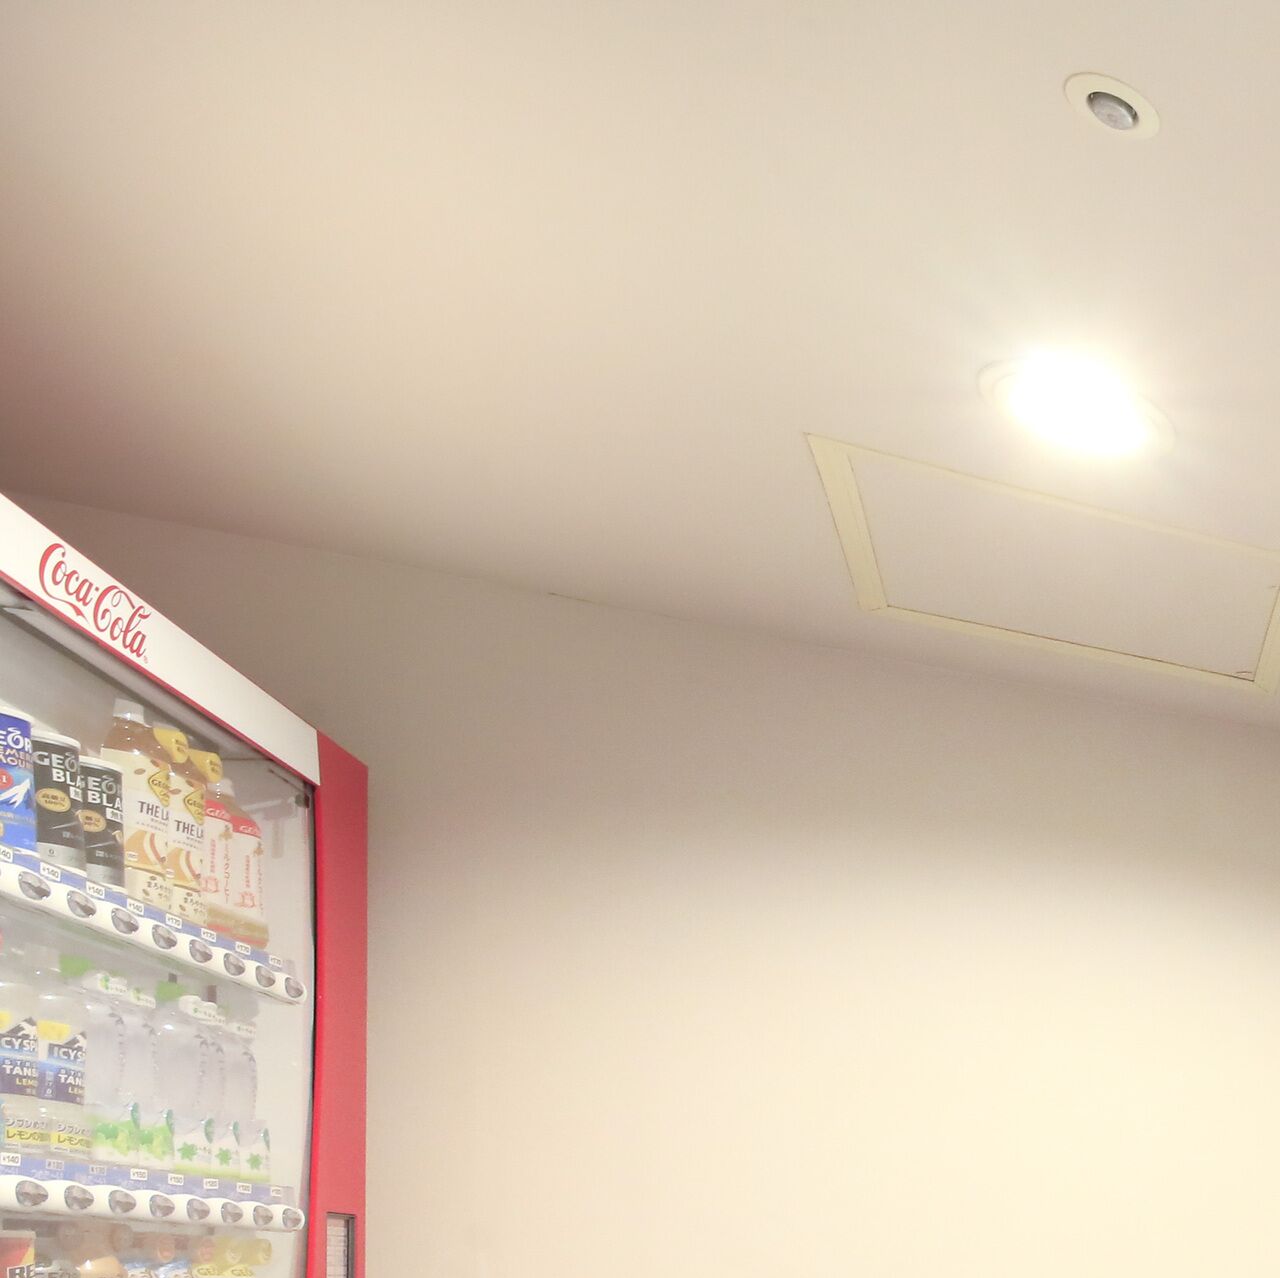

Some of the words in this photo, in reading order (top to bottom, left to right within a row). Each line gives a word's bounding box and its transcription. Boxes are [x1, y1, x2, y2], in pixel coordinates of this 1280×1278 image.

[39, 543, 151, 661] Coca-Cola
[138, 800, 160, 819] THE
[174, 820, 196, 839] THE
